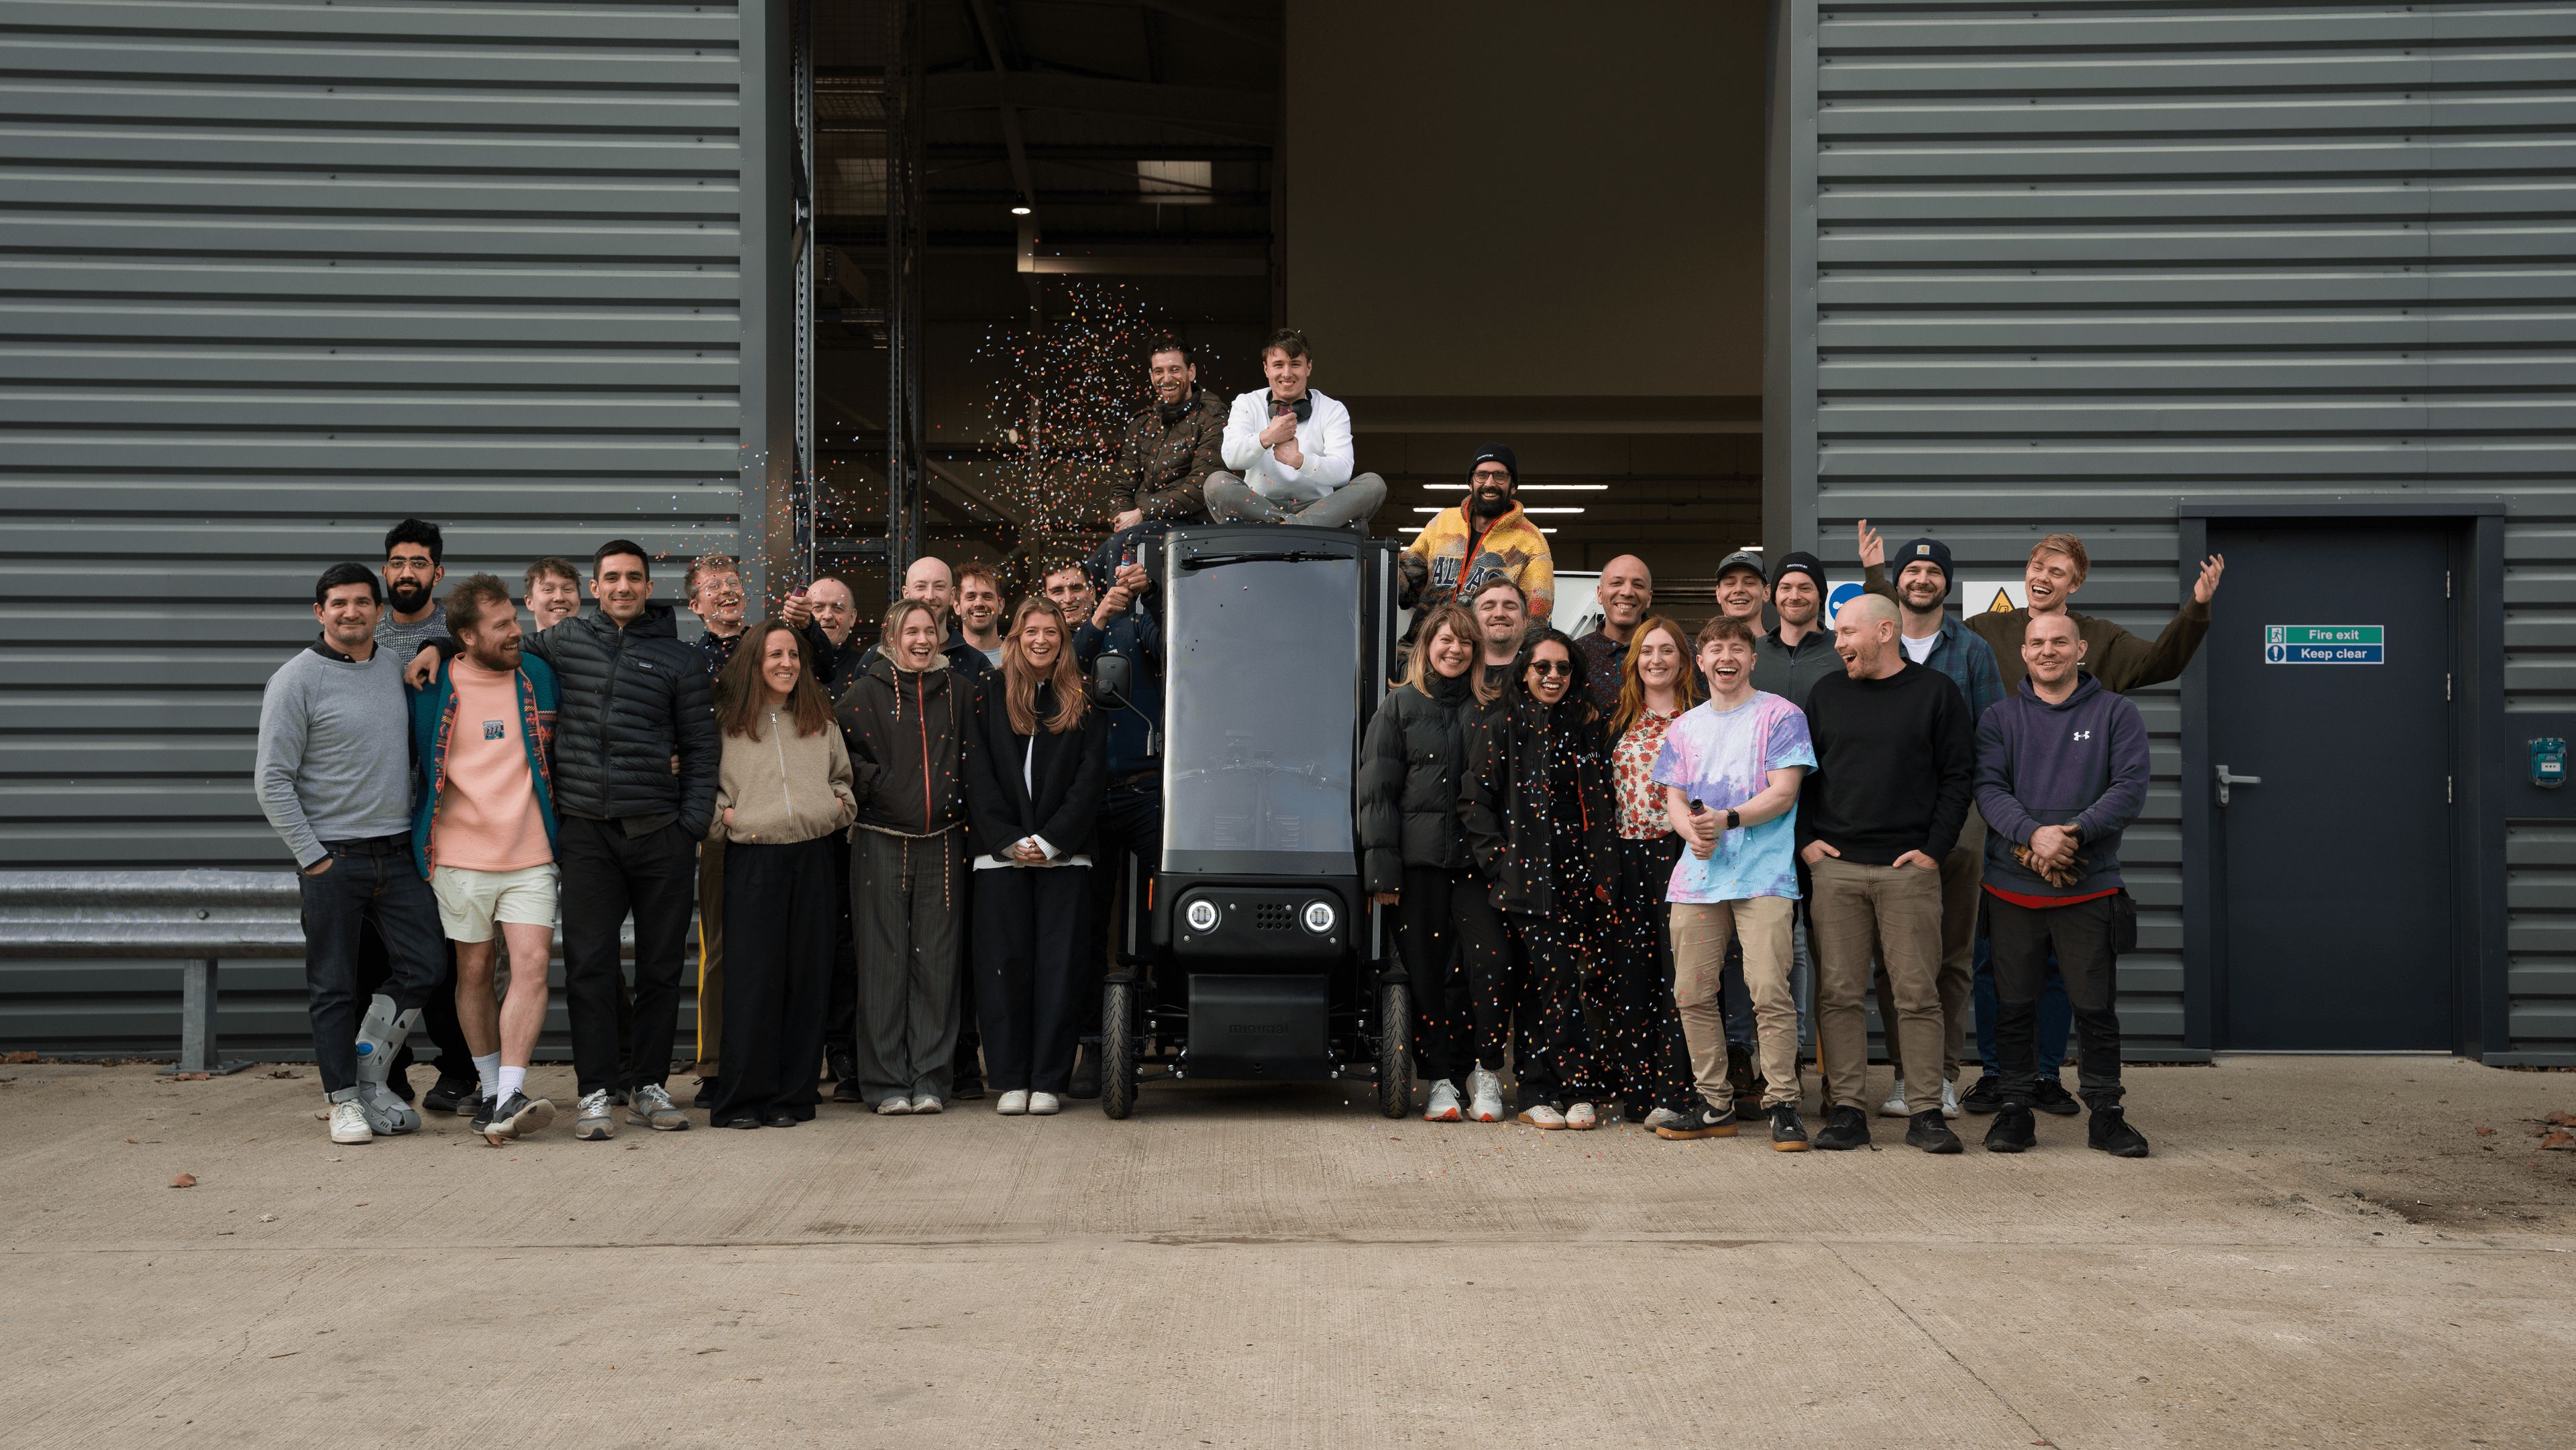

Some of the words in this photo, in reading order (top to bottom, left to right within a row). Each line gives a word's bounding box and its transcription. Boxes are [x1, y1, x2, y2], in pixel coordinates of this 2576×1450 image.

[2309, 629, 2333, 640] Fire
[2336, 629, 2359, 640] exit
[2301, 648, 2333, 661] Keep
[2336, 648, 2367, 659] clear
[1229, 1023, 1288, 1034] minimal
